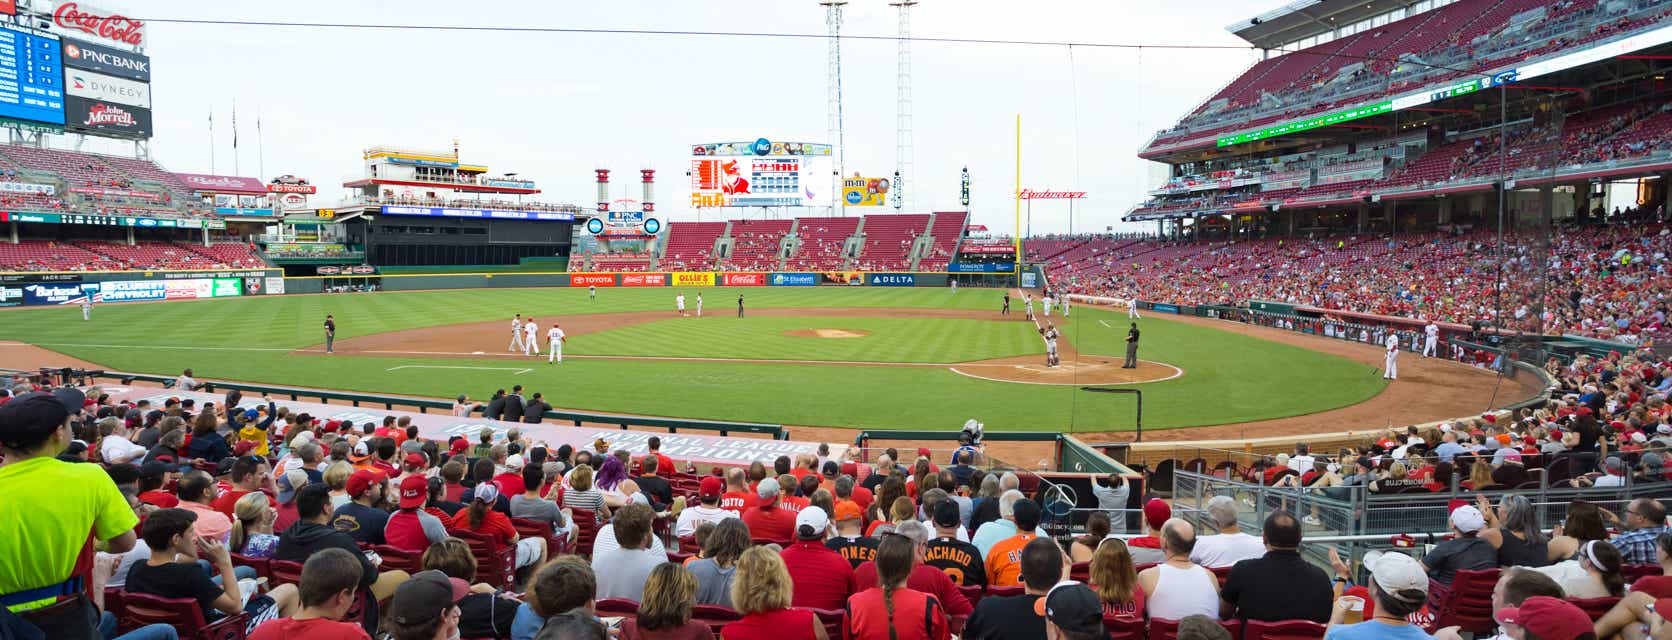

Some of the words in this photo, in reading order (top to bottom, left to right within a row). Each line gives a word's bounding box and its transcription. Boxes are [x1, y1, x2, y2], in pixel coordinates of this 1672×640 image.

[91, 81, 142, 97] DYNEGY
[83, 110, 137, 124] Morrell
[284, 184, 312, 193] TOYOTA
[1017, 188, 1087, 200] Budweiser
[585, 276, 612, 284] TOYOTA
[882, 275, 913, 284] DELTA
[721, 497, 744, 508] OTTO
[840, 545, 877, 561] ONES
[924, 546, 972, 567] ACHADO
